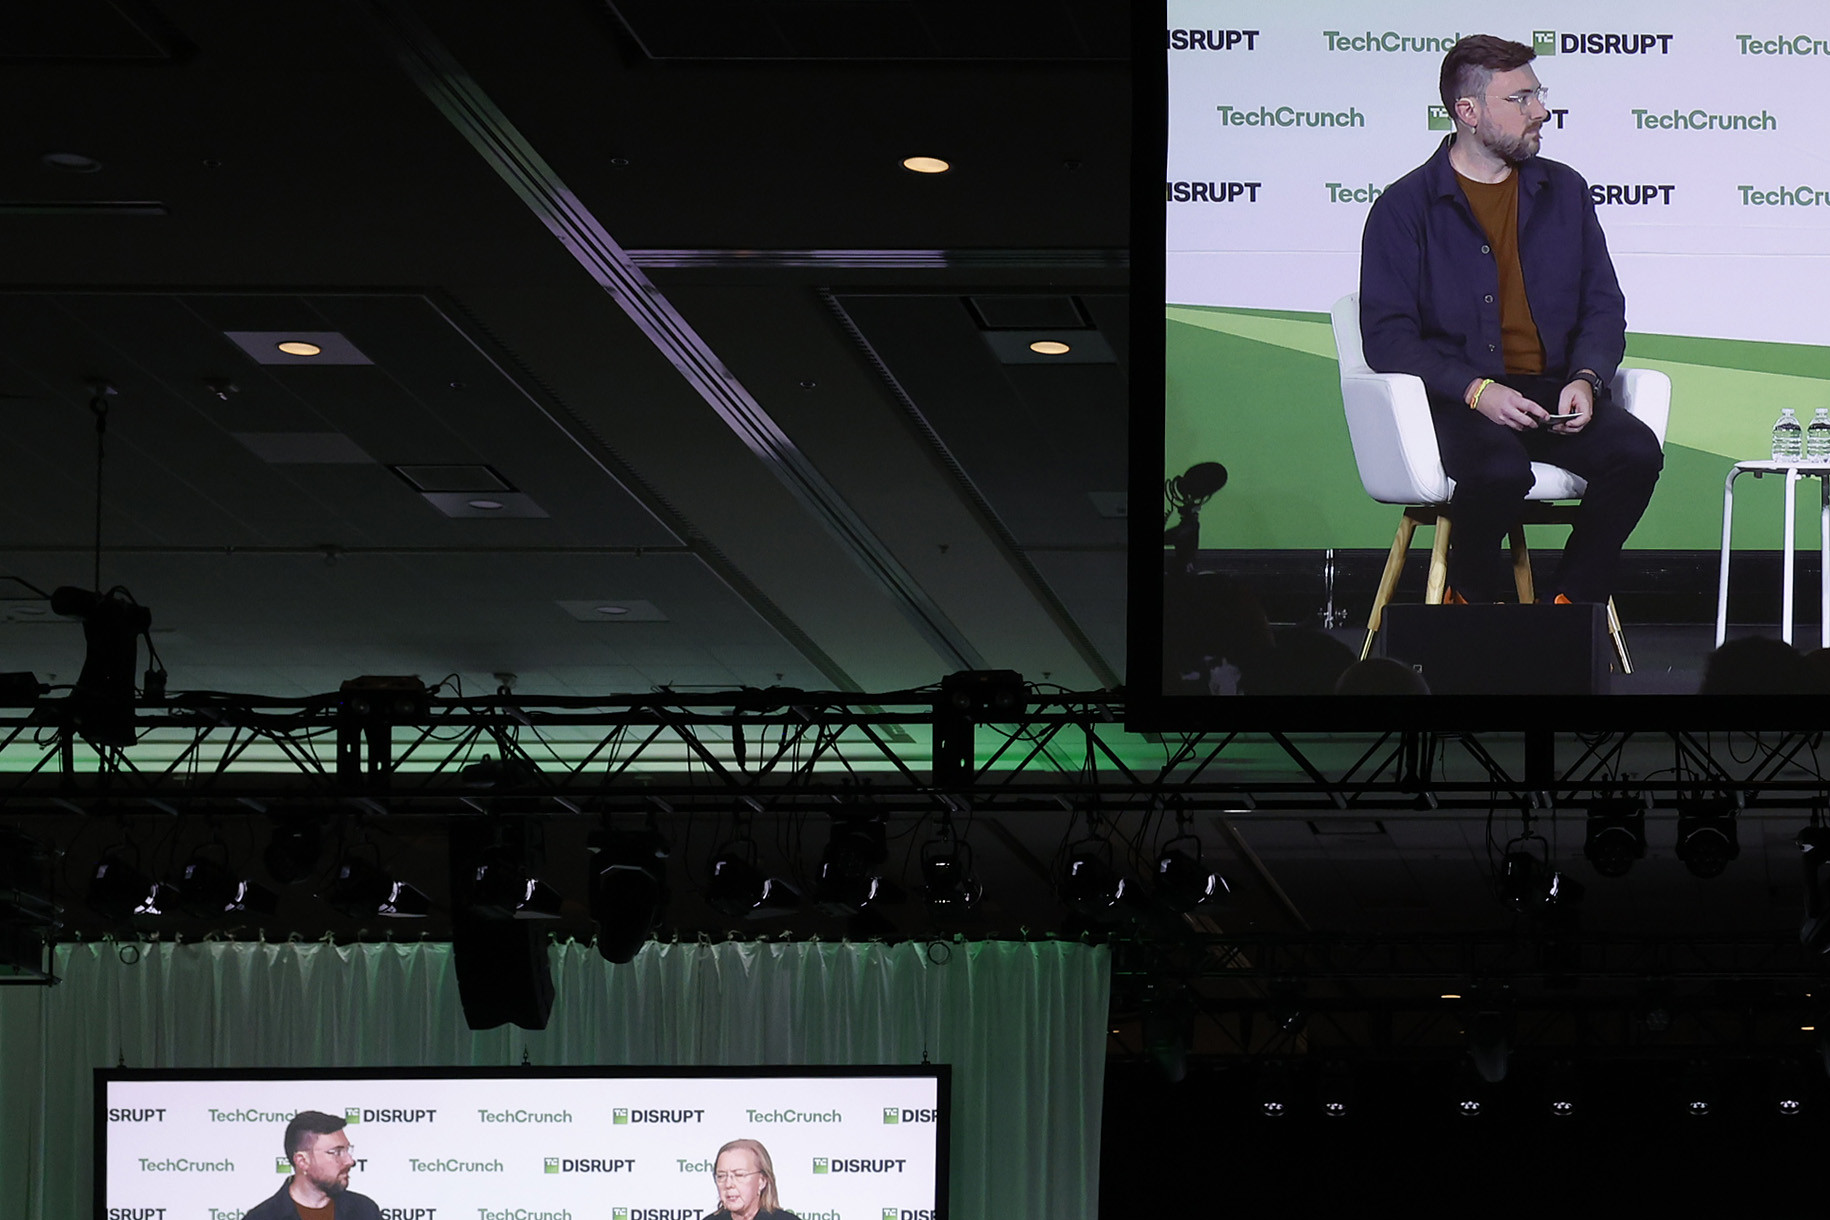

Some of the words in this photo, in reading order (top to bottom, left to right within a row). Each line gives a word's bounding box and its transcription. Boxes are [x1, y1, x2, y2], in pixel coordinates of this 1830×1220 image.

[1167, 29, 1260, 51] ISRUPT
[1534, 33, 1554, 43] TC
[1561, 33, 1674, 54] DISRUPT
[1216, 105, 1365, 127] TechCrunch
[1631, 109, 1777, 130] TechCrunch
[1167, 182, 1262, 203] ISRUPT
[1589, 184, 1676, 205] SRUPT
[363, 1109, 437, 1123] DISRUPT
[478, 1109, 573, 1123] TechCrunch
[631, 1109, 705, 1123] DISRUPT
[747, 1109, 842, 1123] TechCrunch
[138, 1158, 235, 1172] TechCrunch
[409, 1158, 504, 1172] TechCrunch
[562, 1159, 636, 1173] DISRUPT
[831, 1159, 907, 1173] DISRUPT
